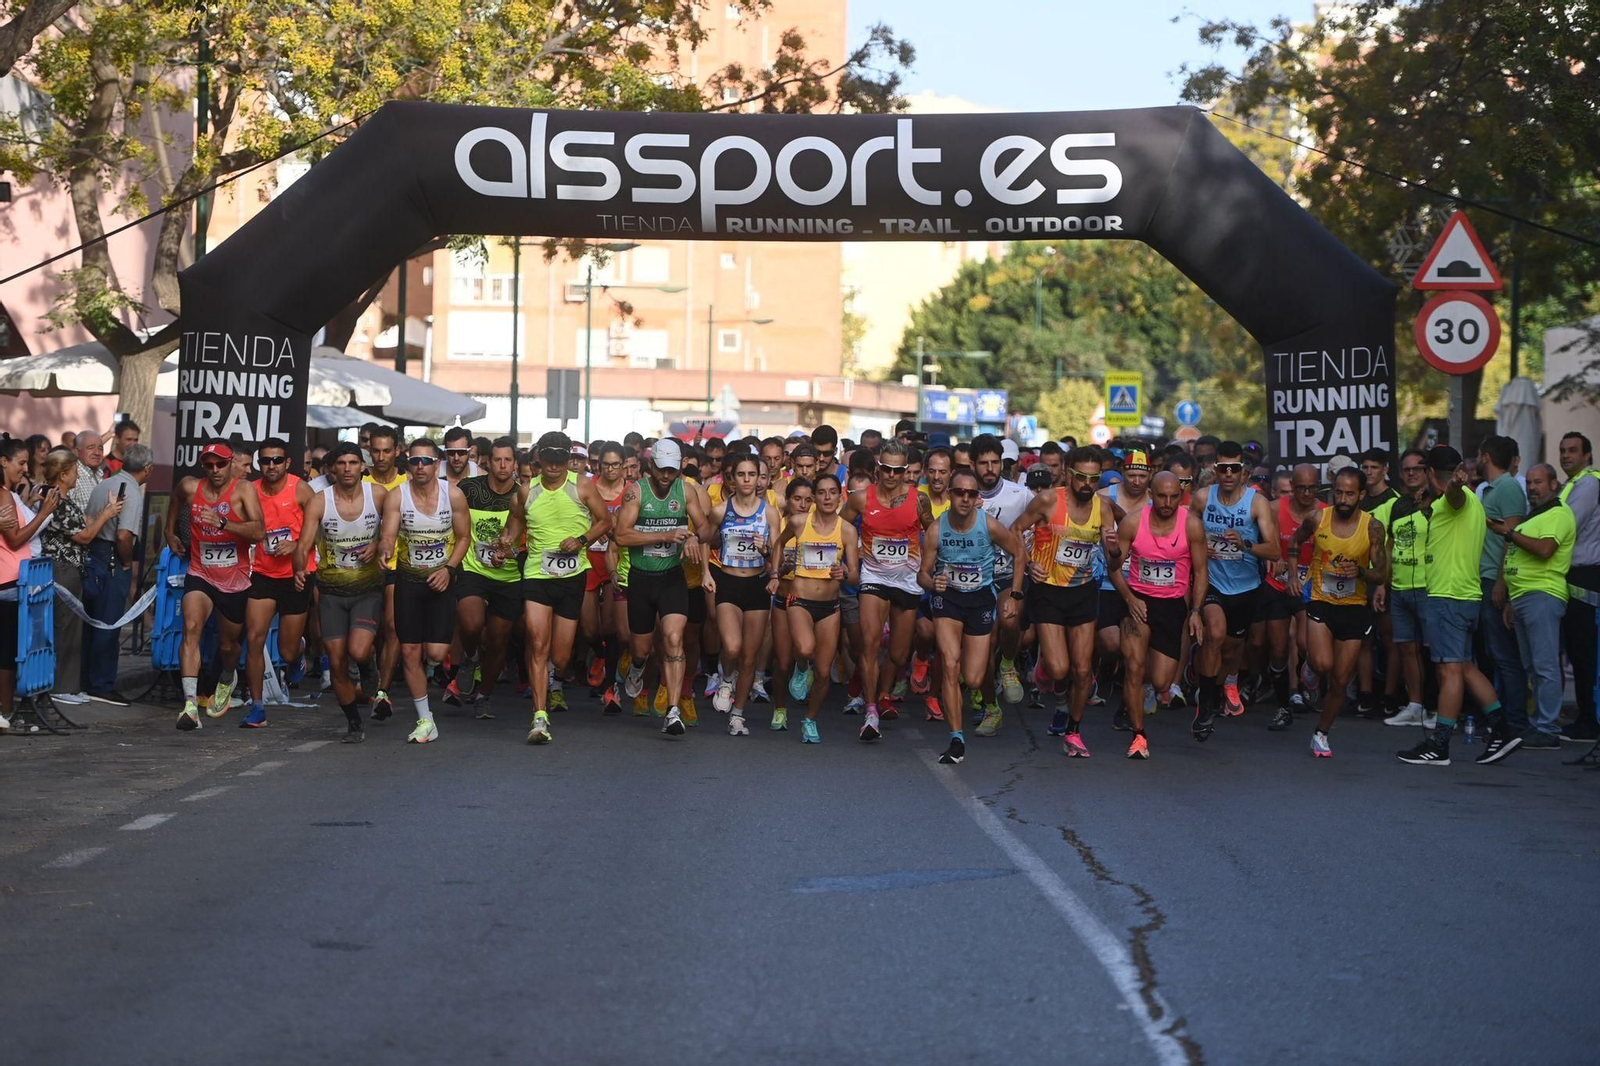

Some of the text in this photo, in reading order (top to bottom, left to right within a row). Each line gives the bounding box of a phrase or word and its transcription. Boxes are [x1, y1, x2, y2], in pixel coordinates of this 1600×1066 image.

[454, 112, 1123, 233] alssport.es
[596, 214, 695, 232] TIENDA
[726, 217, 854, 234] RUNNING
[880, 218, 960, 234] TRAIL
[986, 215, 1124, 233] OUTDOOR
[1434, 318, 1480, 345] 30
[183, 332, 295, 368] TIENDA
[1273, 345, 1389, 383] TIENDA
[179, 369, 294, 399] RUNNING
[1273, 383, 1389, 414] RUNNING
[178, 400, 290, 443] TRAIL
[1274, 415, 1390, 458] TRAIL
[645, 518, 677, 526] ATLETISMO
[1207, 513, 1244, 528] nerja
[737, 541, 756, 552] 54
[942, 537, 974, 548] nerja
[1210, 540, 1239, 552] 723
[205, 548, 235, 560] 572
[340, 551, 359, 562] 75
[414, 548, 444, 561] 528
[816, 550, 823, 561] 1
[876, 544, 906, 556] 290
[1063, 546, 1090, 559] 501
[546, 556, 577, 569] 760
[948, 571, 980, 583] 162
[1143, 565, 1173, 578] 513
[1336, 581, 1345, 591] 6
